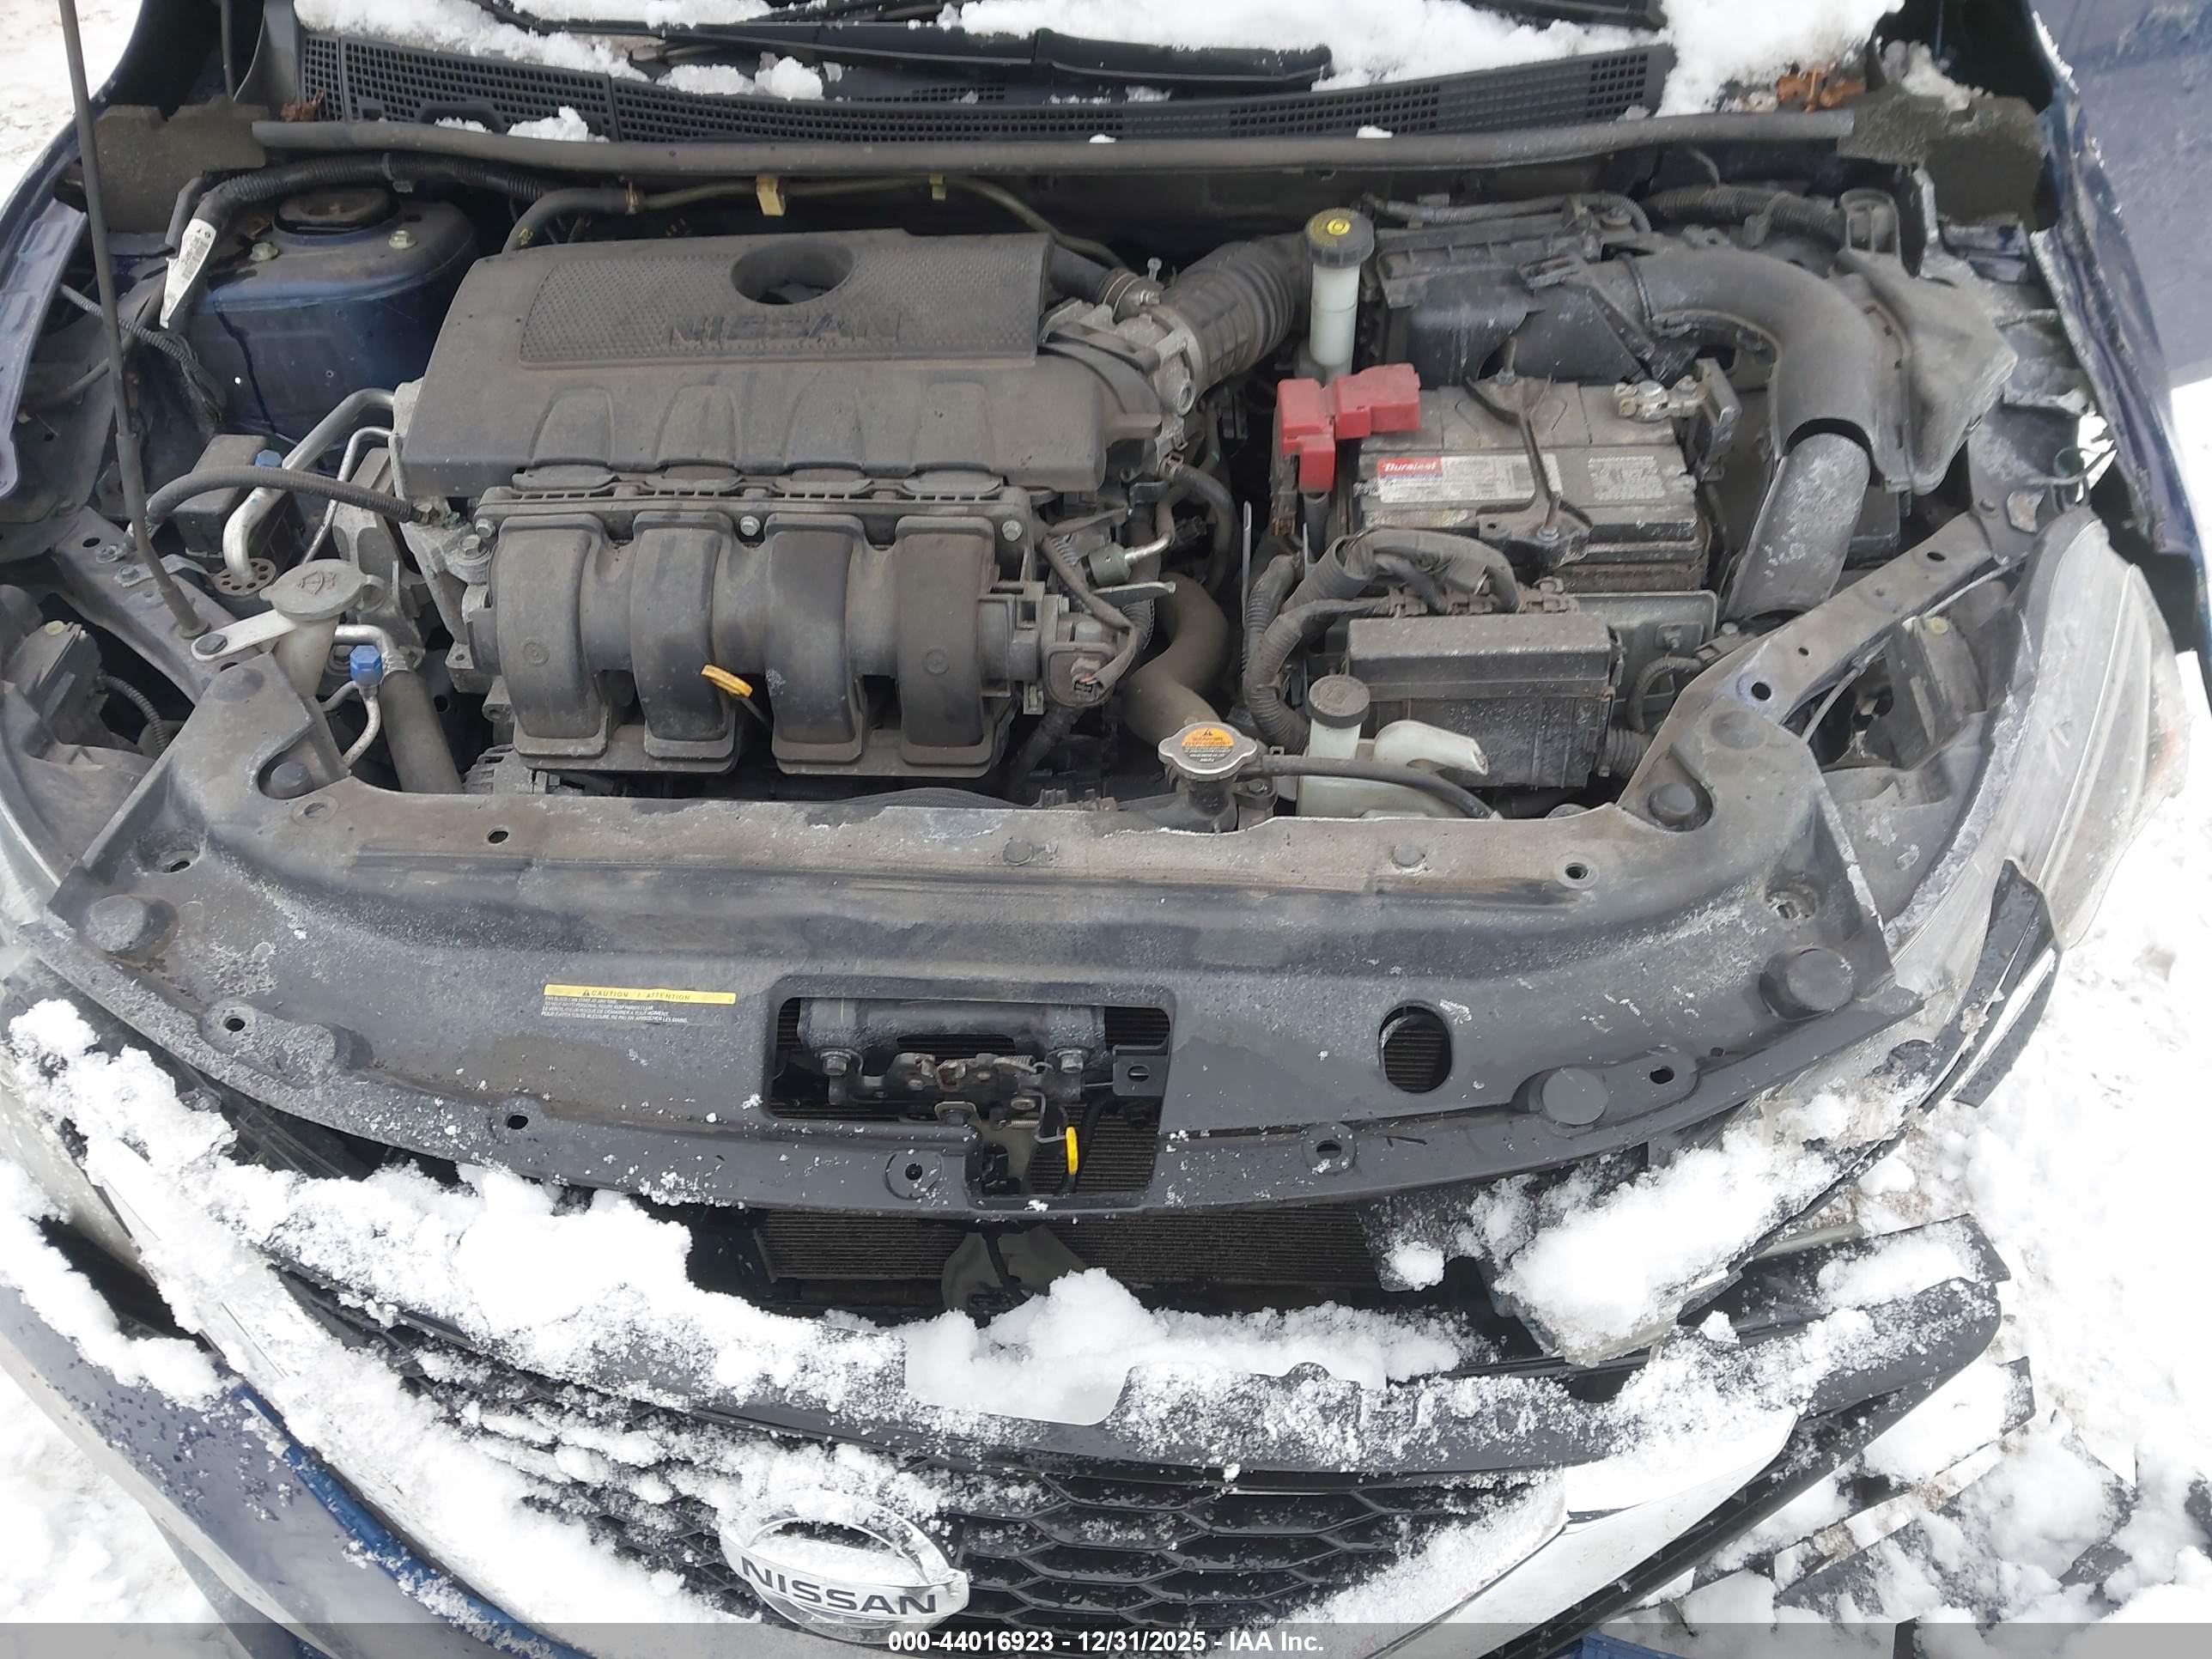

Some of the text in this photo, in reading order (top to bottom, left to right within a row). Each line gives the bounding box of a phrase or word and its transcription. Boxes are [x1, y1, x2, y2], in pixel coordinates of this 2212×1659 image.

[668, 312, 901, 345] NISSAN
[646, 992, 690, 1000] ATTENTION
[741, 1556, 936, 1615] NISSAN
